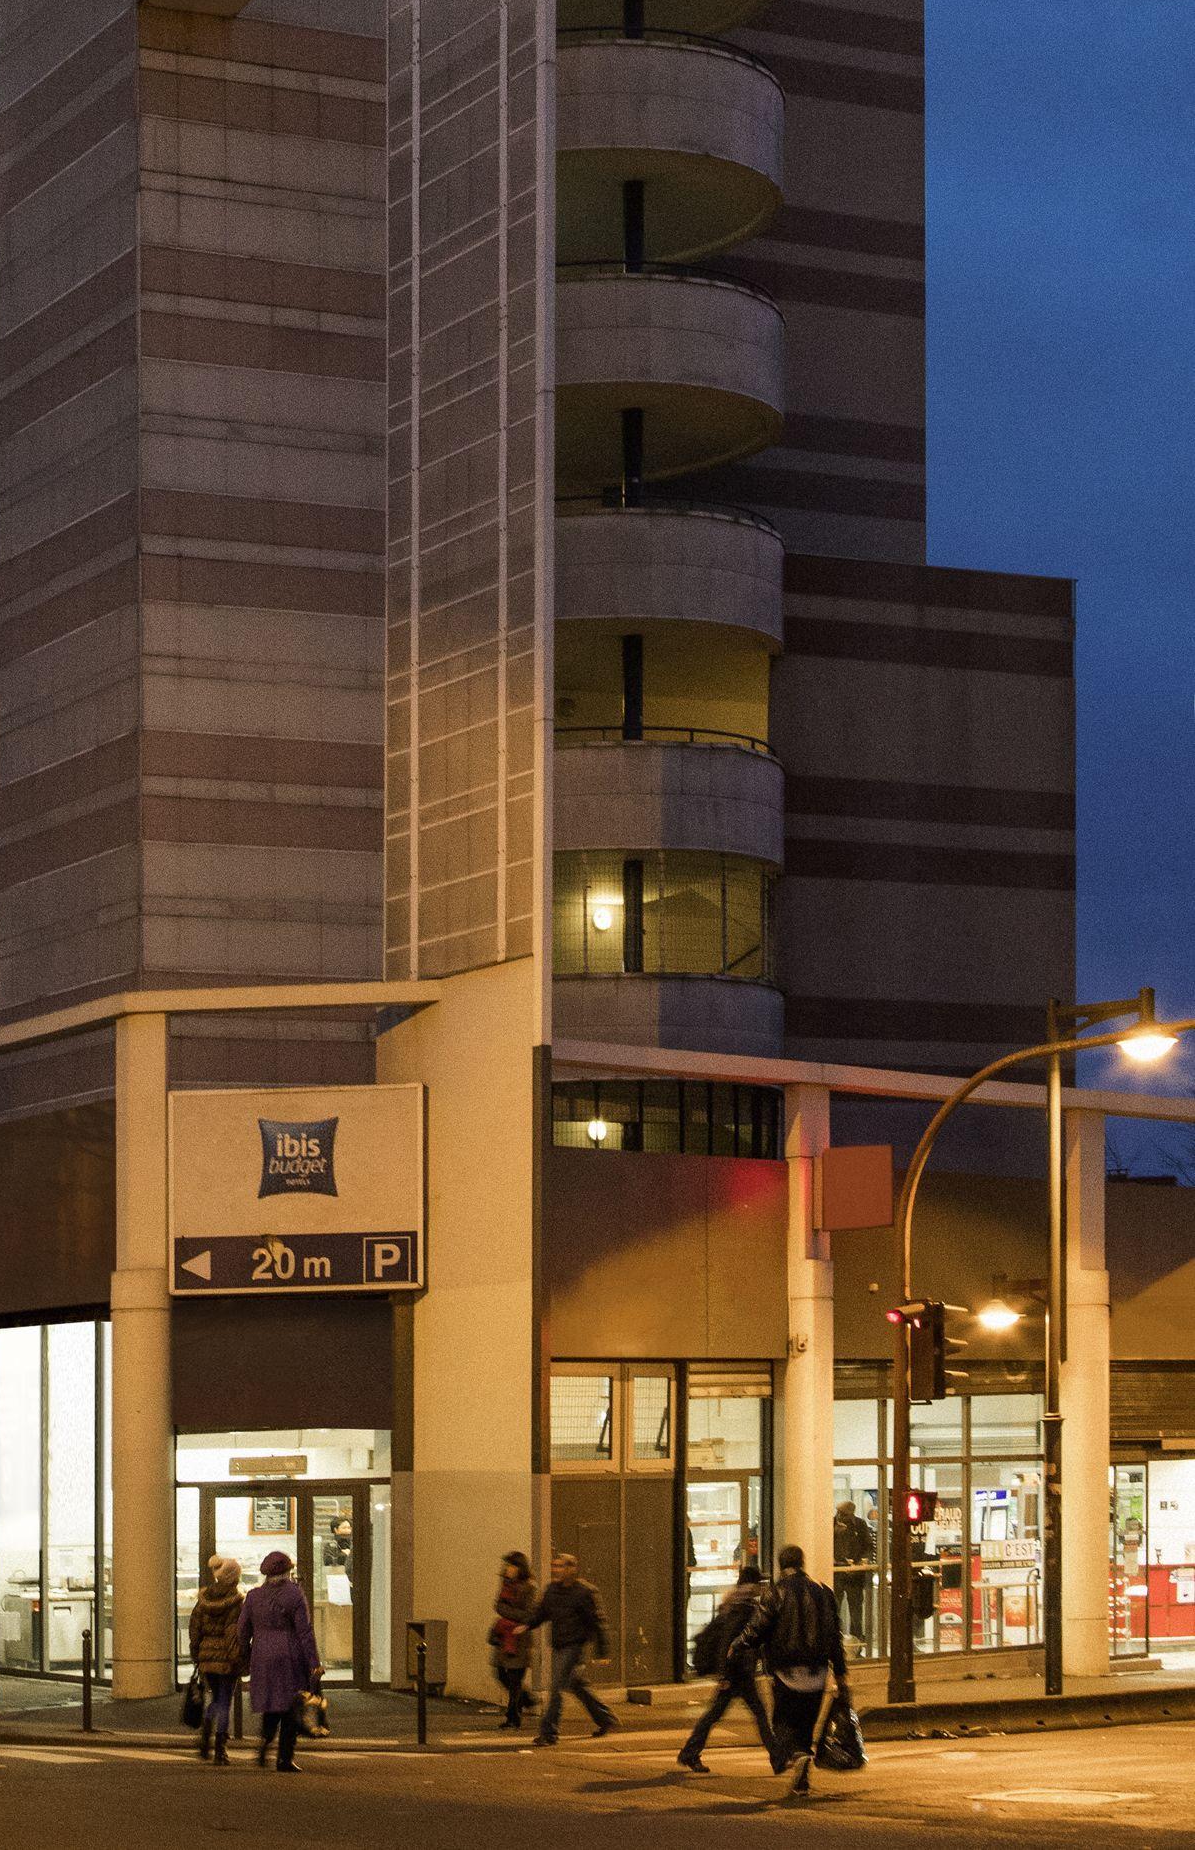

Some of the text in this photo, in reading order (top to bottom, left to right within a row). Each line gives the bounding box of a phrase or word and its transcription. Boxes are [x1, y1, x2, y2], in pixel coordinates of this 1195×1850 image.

[276, 1133, 321, 1158] ibis
[268, 1157, 328, 1178] budget
[252, 1243, 401, 1280] 20 m P
